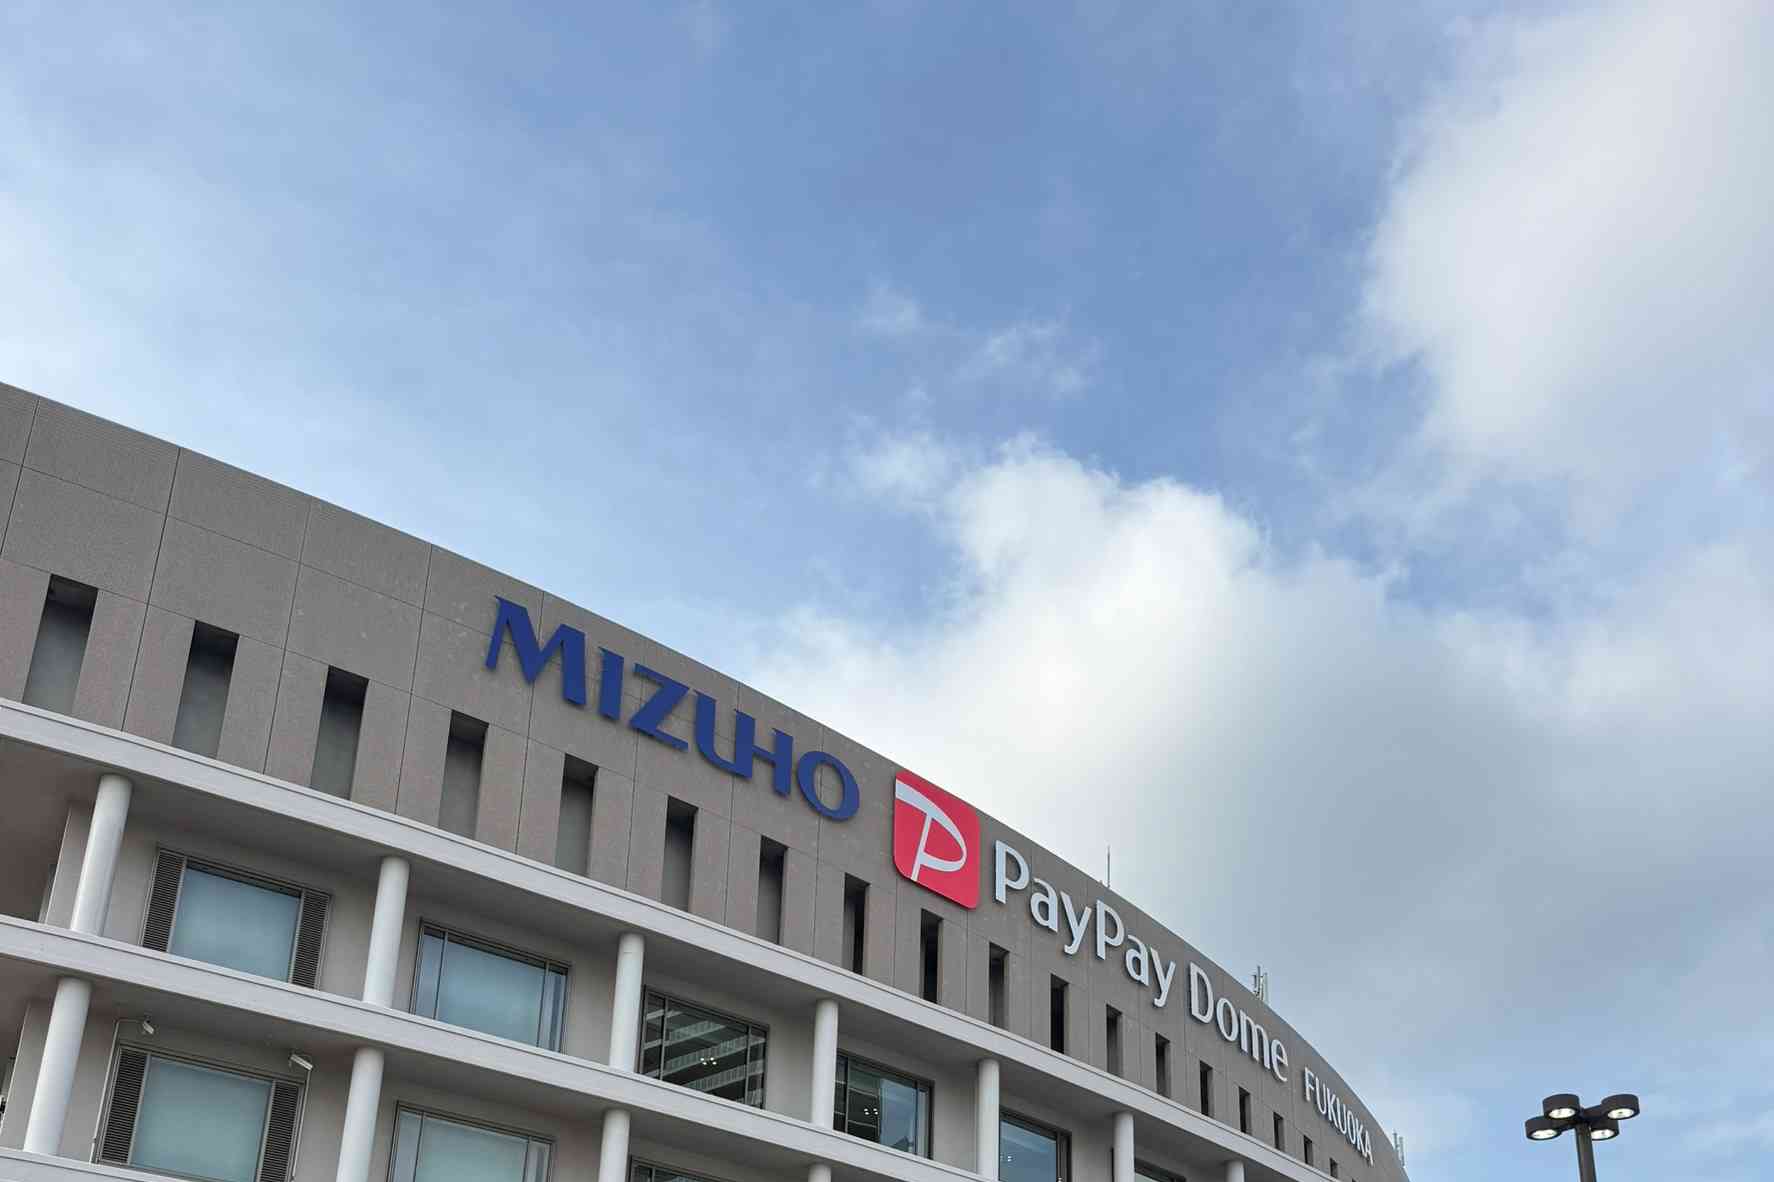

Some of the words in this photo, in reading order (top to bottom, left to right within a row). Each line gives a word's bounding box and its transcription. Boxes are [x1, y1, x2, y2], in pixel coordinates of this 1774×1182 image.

[485, 596, 859, 821] MIZUHO
[993, 840, 1177, 1008] PayPay
[1189, 961, 1288, 1082] Dome
[1304, 1066, 1375, 1166] FUKUOKA
